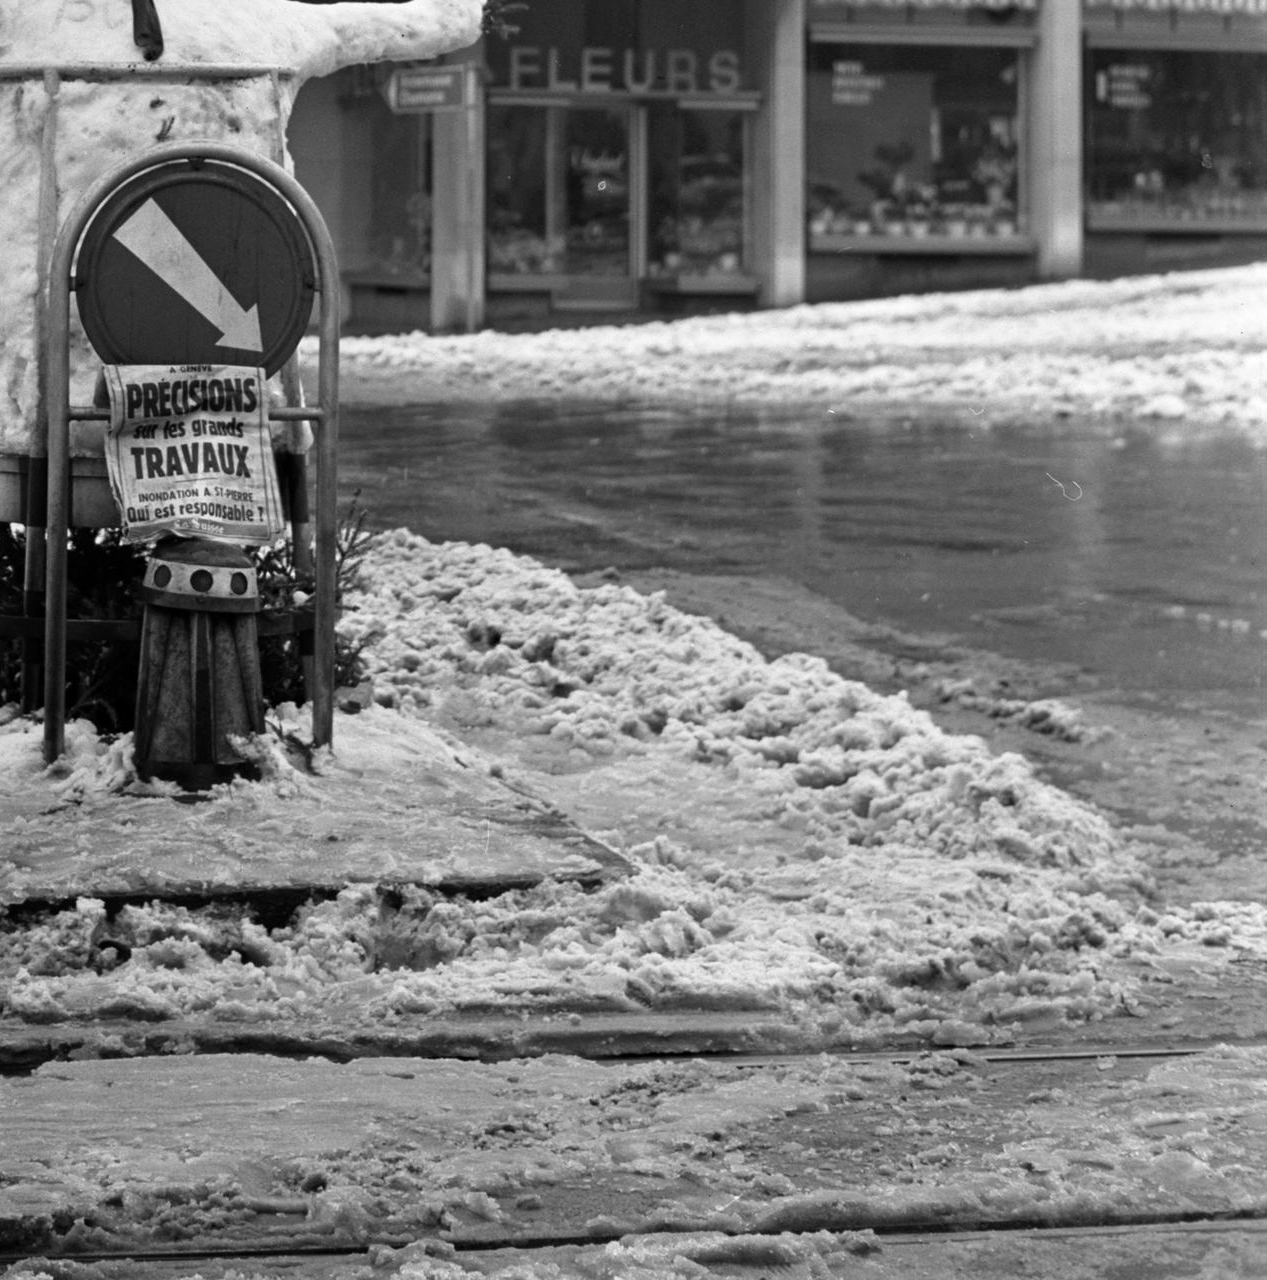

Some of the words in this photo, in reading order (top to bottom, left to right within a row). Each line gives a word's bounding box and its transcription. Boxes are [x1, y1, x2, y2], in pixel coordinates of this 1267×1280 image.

[510, 47, 741, 92] FLEURS
[125, 377, 257, 419] PRÉCISIONS
[133, 424, 159, 439] sur
[163, 420, 186, 440] les
[192, 417, 244, 438] grands
[130, 442, 251, 479] TRAVAUX
[138, 488, 199, 502] INONDATION
[127, 506, 150, 522] Qui
[154, 504, 175, 518] est
[179, 502, 254, 522] responsable
